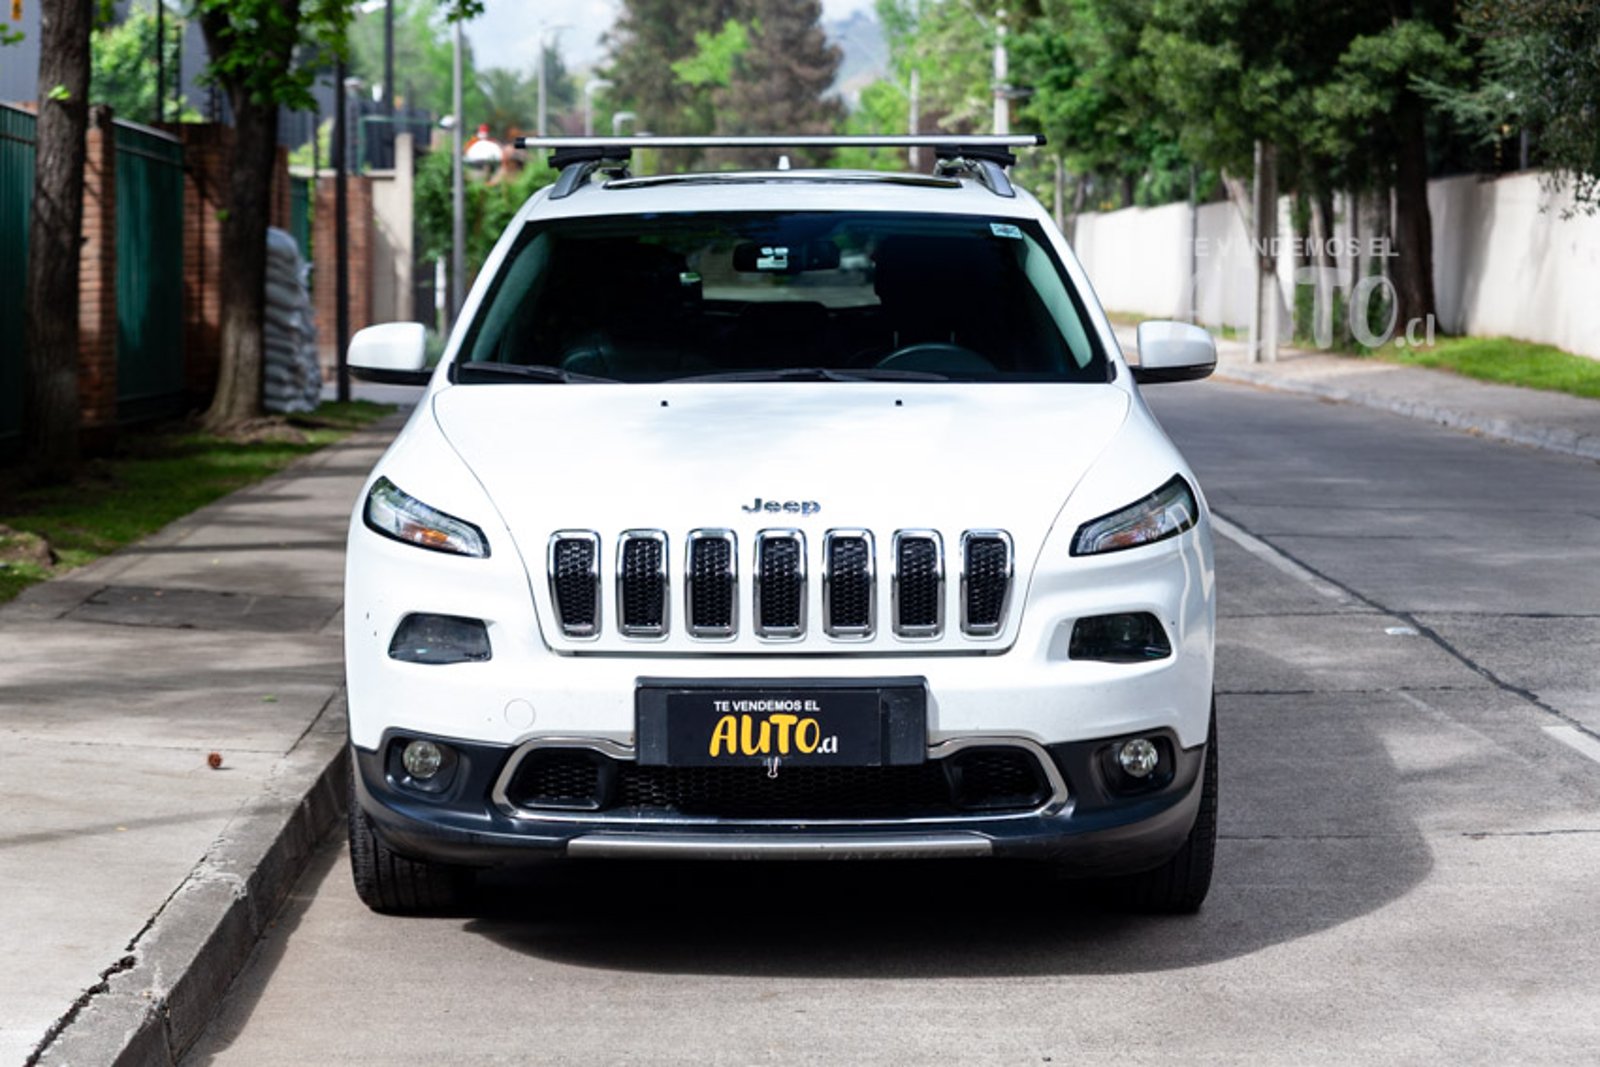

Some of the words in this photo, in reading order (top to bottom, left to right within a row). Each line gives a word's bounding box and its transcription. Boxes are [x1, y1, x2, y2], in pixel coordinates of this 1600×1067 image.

[741, 497, 821, 516] Jeep
[713, 700, 730, 712] TE
[732, 700, 802, 712] VENDEMOS
[804, 700, 821, 712] EL
[709, 714, 838, 757] AUTO.cl
